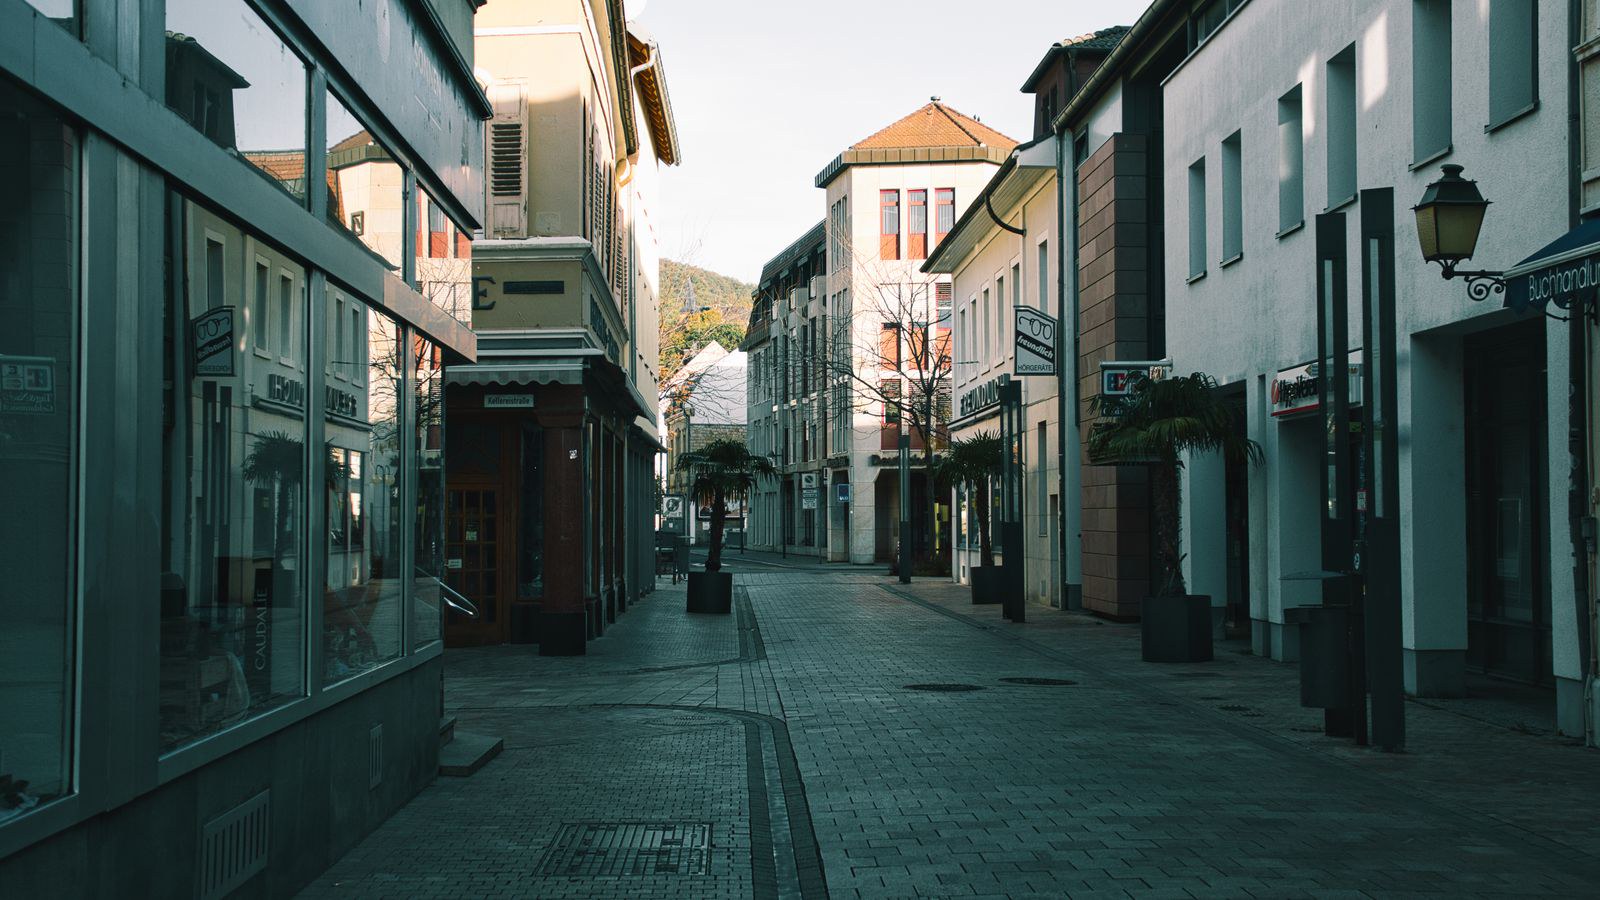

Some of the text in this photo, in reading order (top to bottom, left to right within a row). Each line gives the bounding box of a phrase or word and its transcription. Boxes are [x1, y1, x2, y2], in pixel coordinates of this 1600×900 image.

[1017, 335, 1054, 359] freundlich
[1017, 363, 1053, 372] HÖRGERÄTE
[487, 396, 531, 406] Kellereistraße
[255, 586, 268, 671] CAUDALIE
